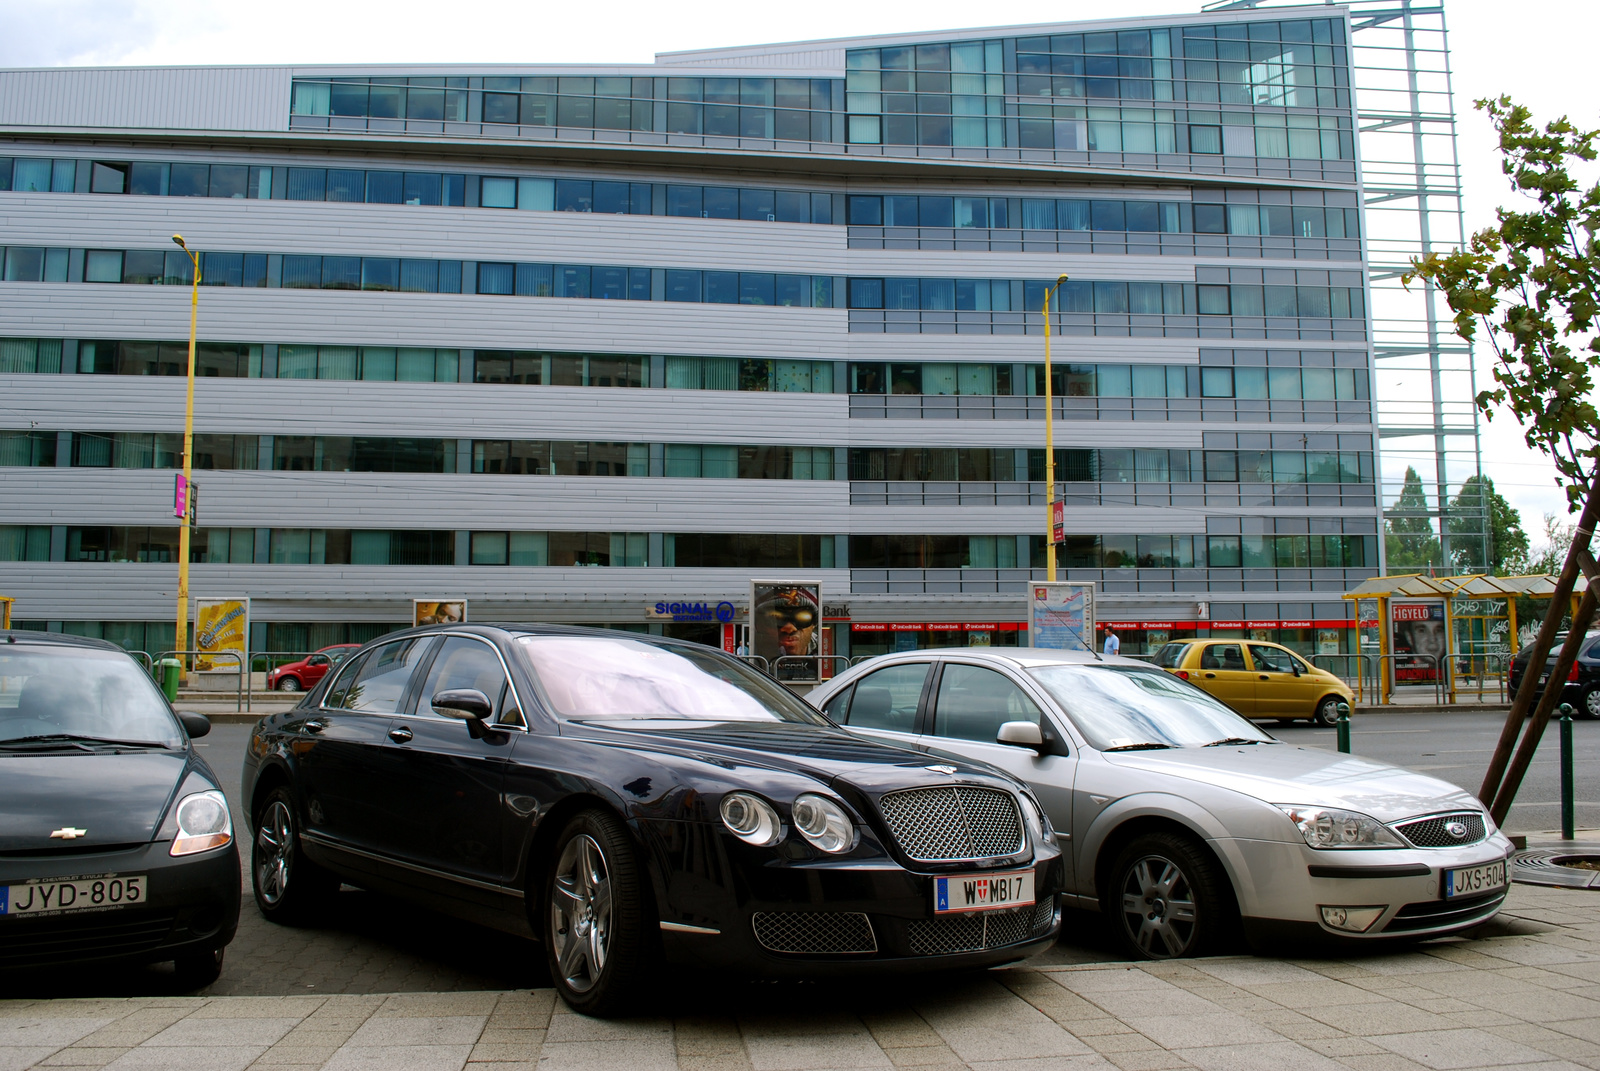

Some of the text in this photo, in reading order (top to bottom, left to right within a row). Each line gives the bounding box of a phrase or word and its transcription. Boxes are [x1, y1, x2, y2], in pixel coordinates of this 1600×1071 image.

[655, 602, 713, 614] SIGNAL
[823, 605, 851, 617] Bank
[1456, 864, 1504, 892] JXS-504
[15, 879, 140, 910] JYD-805
[964, 881, 976, 904] W
